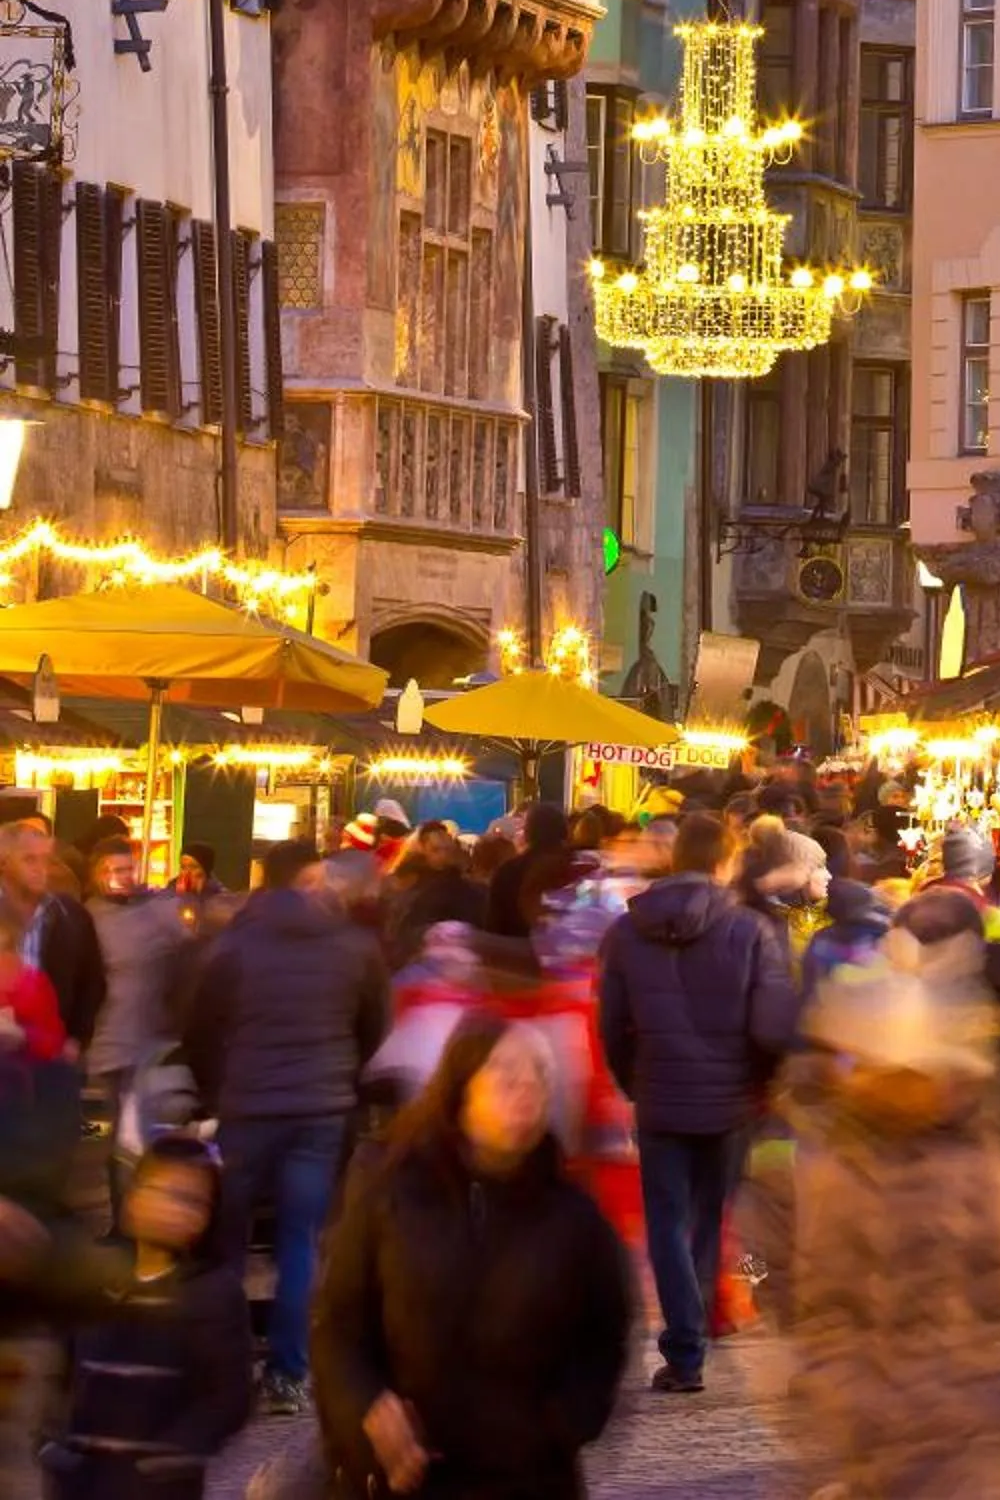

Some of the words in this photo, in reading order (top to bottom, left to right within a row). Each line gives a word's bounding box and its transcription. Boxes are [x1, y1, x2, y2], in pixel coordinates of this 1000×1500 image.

[588, 743, 627, 760] HOT
[631, 749, 672, 767] DOG
[687, 749, 727, 765] DOG
